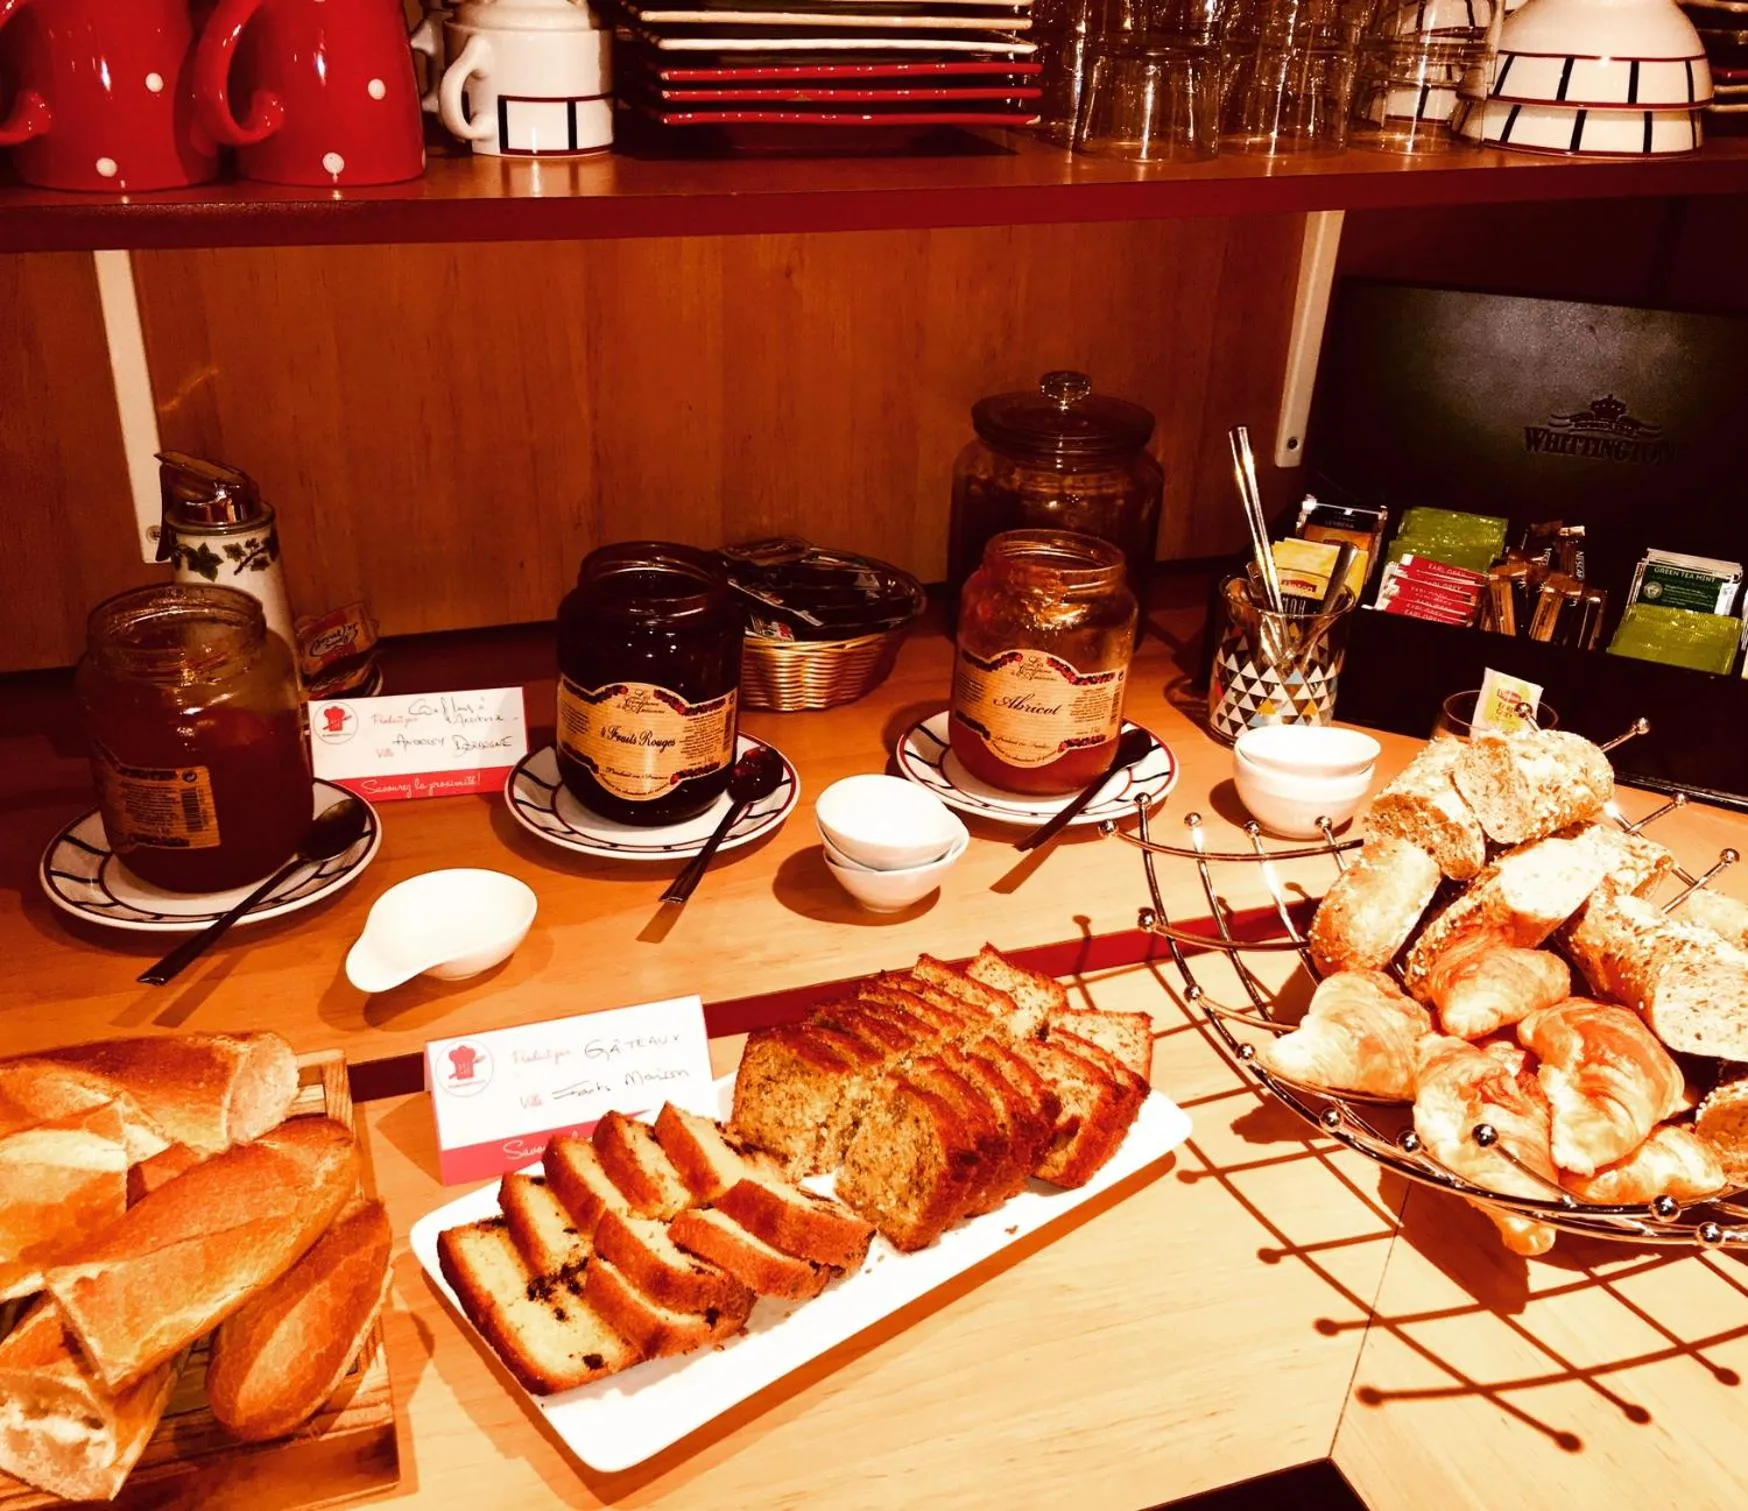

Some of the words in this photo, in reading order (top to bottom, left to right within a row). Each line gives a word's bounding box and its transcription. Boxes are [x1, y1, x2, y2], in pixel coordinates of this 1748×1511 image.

[1653, 567, 1679, 576] GREEN
[1680, 571, 1695, 579] TEA
[1695, 574, 1716, 583] MINT
[993, 692, 1063, 716] Abricot
[606, 725, 638, 745] Fruits
[638, 730, 677, 753] Rouges
[413, 778, 425, 790] la
